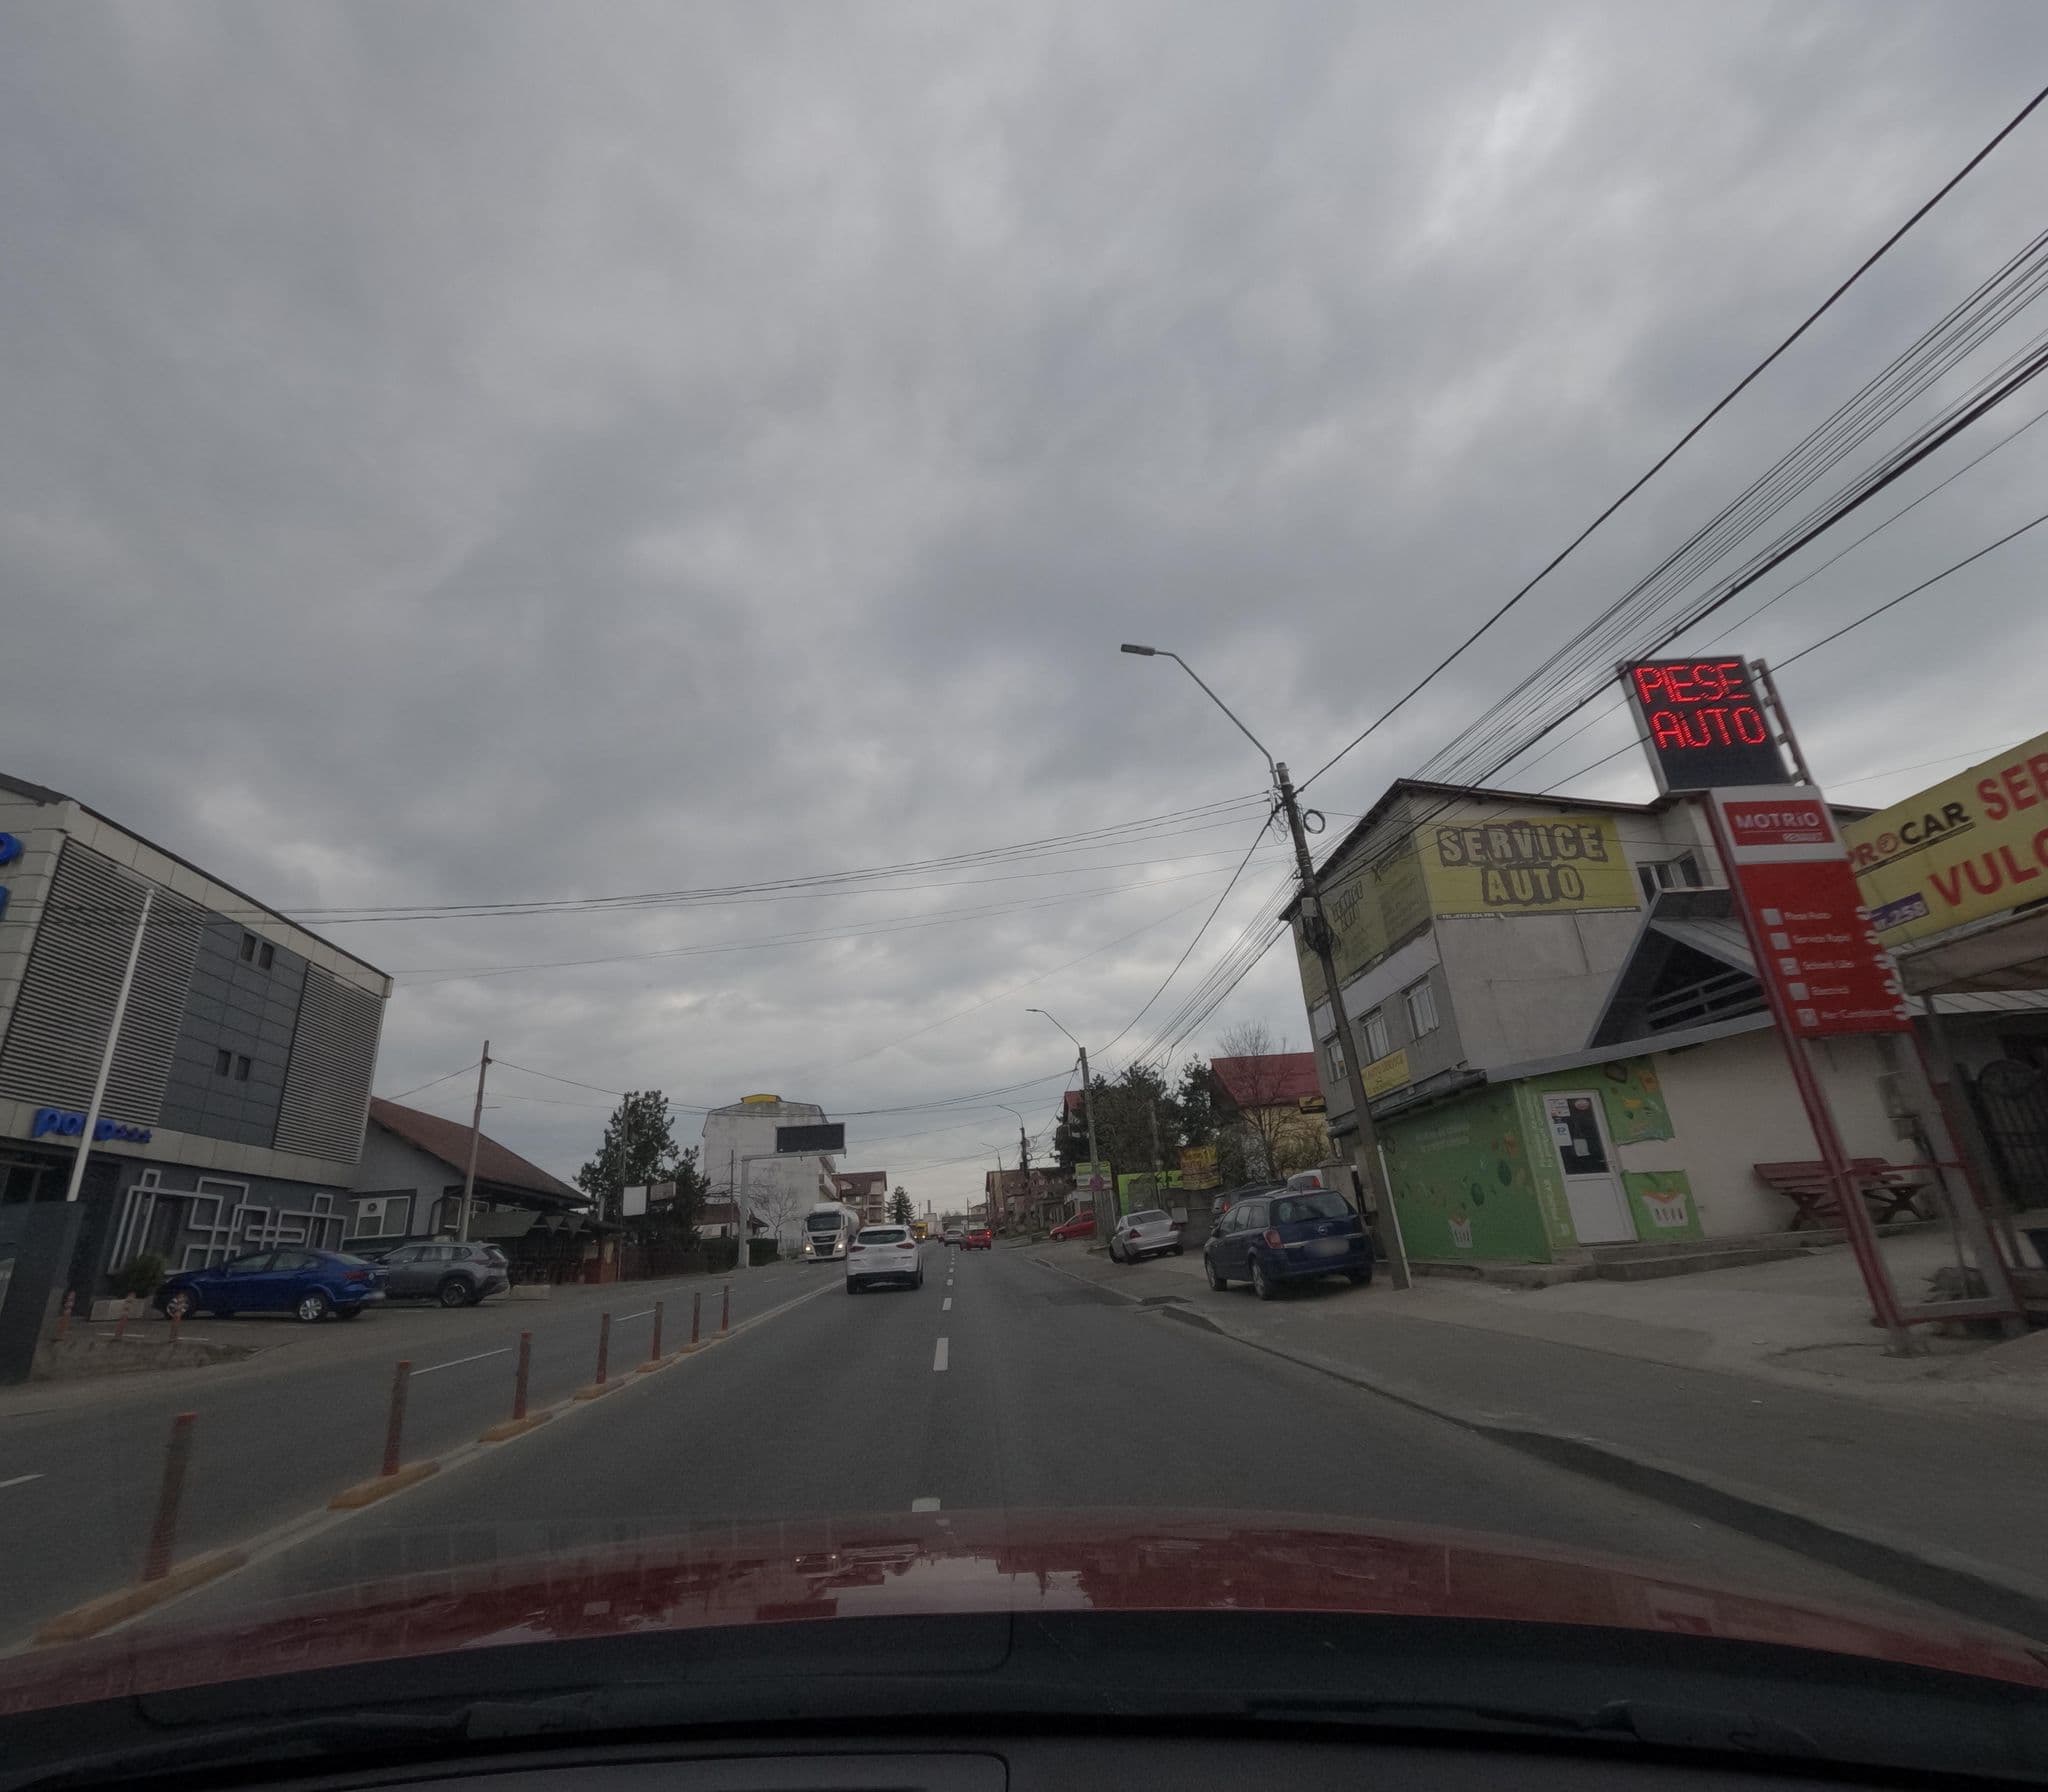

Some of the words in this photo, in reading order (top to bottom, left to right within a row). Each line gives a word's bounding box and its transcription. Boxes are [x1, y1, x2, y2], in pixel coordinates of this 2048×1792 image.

[1634, 662, 1751, 703] PIESE
[1650, 706, 1767, 749] AUTO
[1735, 812, 1820, 830] MOTRIO
[1437, 822, 1607, 867] SERVICE
[1481, 864, 1585, 905] AUTO
